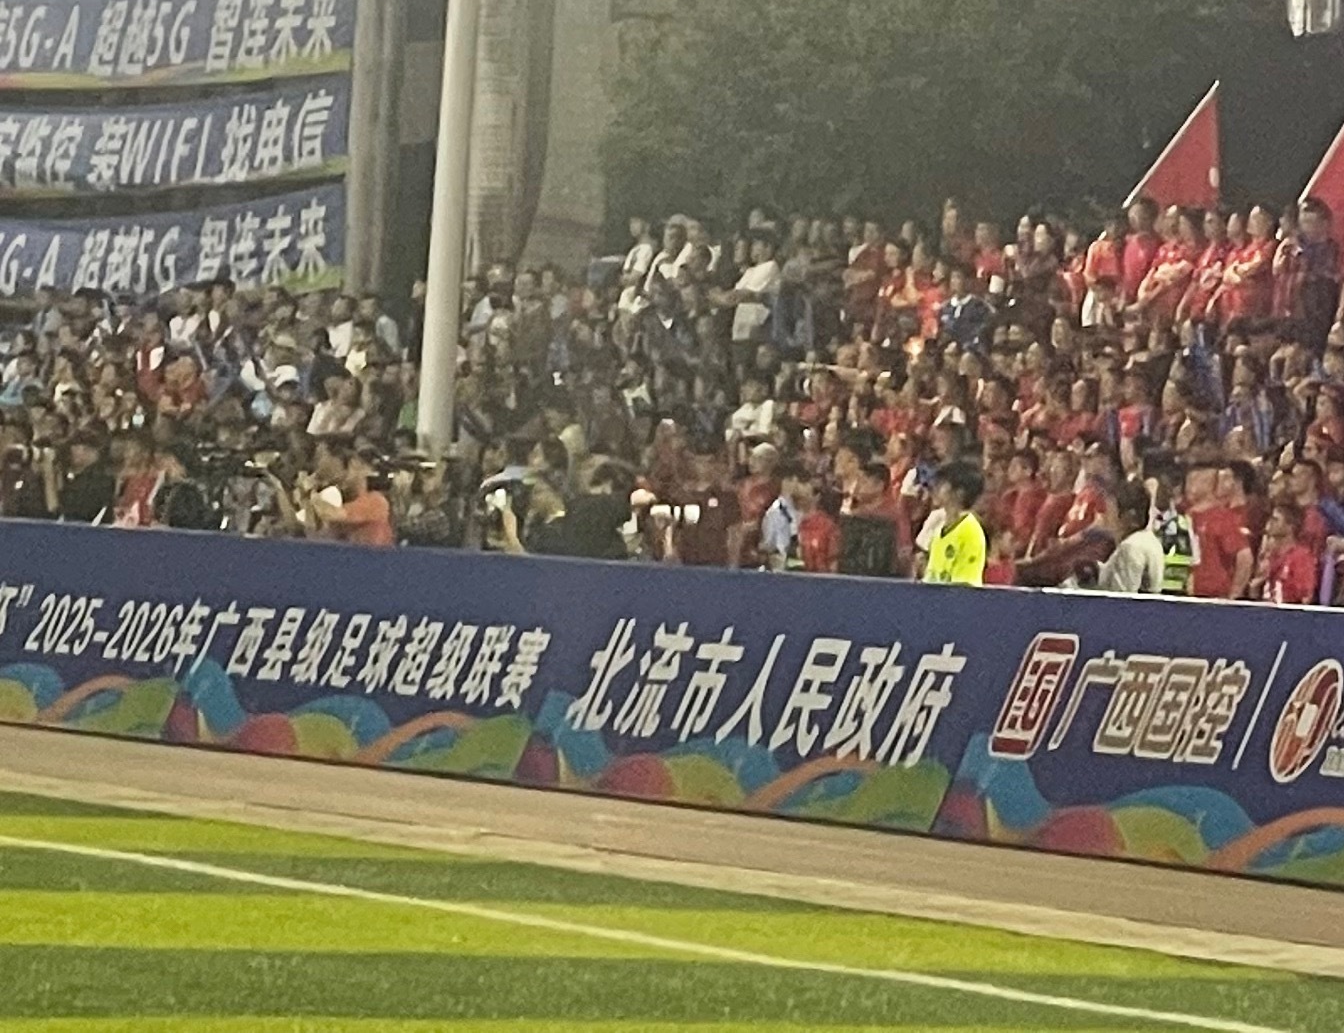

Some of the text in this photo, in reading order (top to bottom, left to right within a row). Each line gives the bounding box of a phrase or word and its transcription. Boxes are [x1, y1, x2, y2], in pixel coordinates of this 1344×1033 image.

[214, 88, 335, 183] 找电信
[195, 197, 328, 286] 智连未来
[564, 617, 967, 769] 北流市人民政府
[1047, 649, 1252, 765] 广西国控
